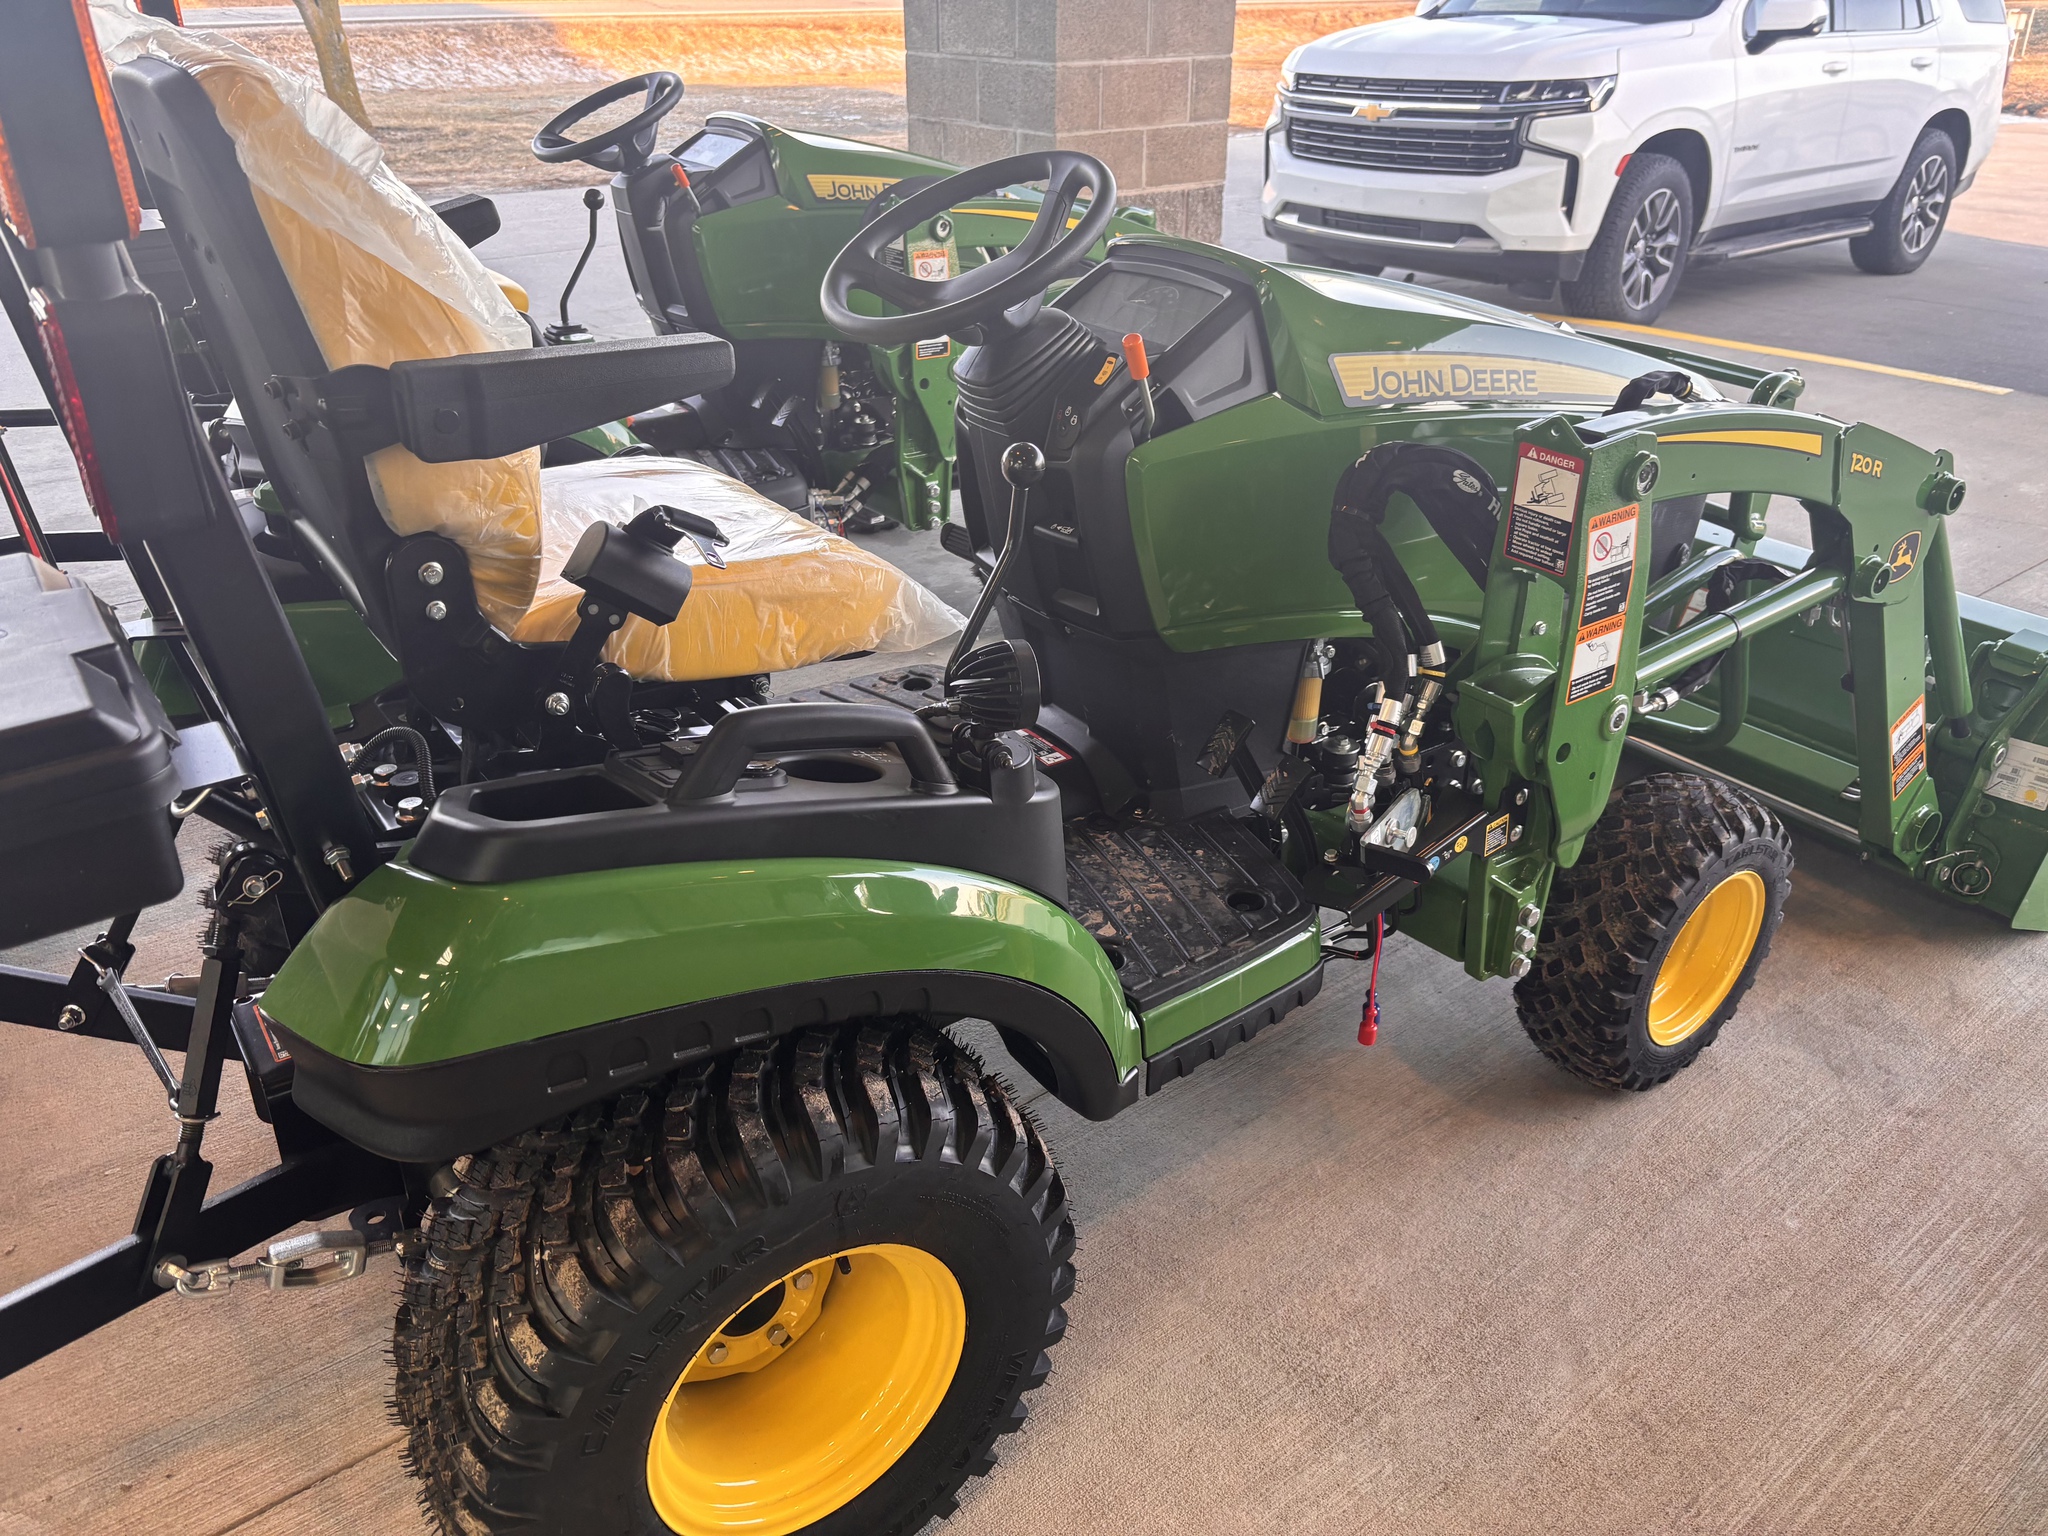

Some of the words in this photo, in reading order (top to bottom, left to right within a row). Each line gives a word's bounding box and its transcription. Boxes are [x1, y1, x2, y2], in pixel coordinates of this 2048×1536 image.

[827, 181, 878, 198] JOHN
[1364, 366, 1445, 397] JOHN
[1450, 363, 1539, 392] DEERE
[1539, 452, 1575, 470] DANGER
[1850, 452, 1872, 474] 120
[1872, 459, 1884, 478] R
[1453, 472, 1479, 492] Gates
[1599, 507, 1636, 527] WARNING
[1586, 619, 1623, 637] WARNING
[581, 1235, 770, 1458] CARLSTAR
[951, 1349, 1028, 1470] VERSA
